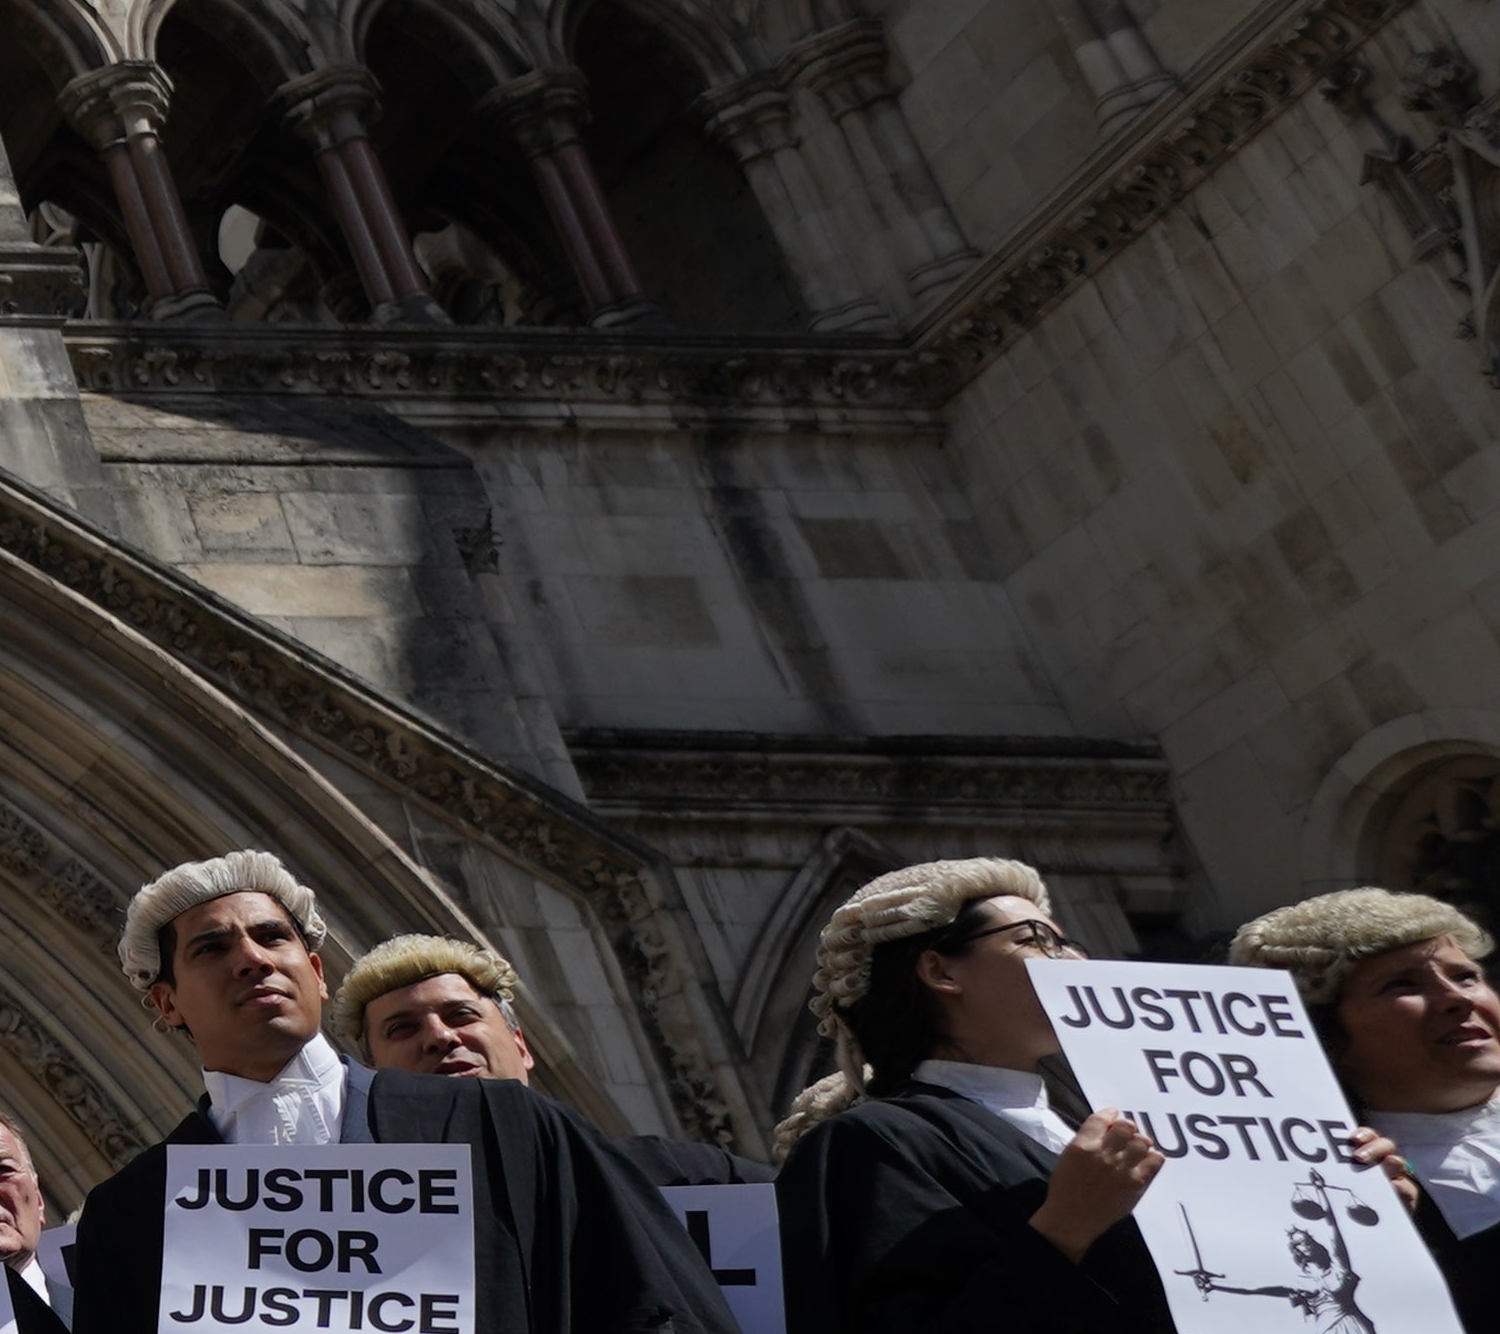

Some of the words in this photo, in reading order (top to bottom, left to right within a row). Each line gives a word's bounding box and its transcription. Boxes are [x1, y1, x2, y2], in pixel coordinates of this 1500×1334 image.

[1059, 984, 1305, 1039] JUSTICE
[1143, 1049, 1273, 1098] FOR
[1124, 1110, 1360, 1164] USTICE
[175, 1168, 460, 1215] JUSTICE
[247, 1227, 382, 1274] FOR
